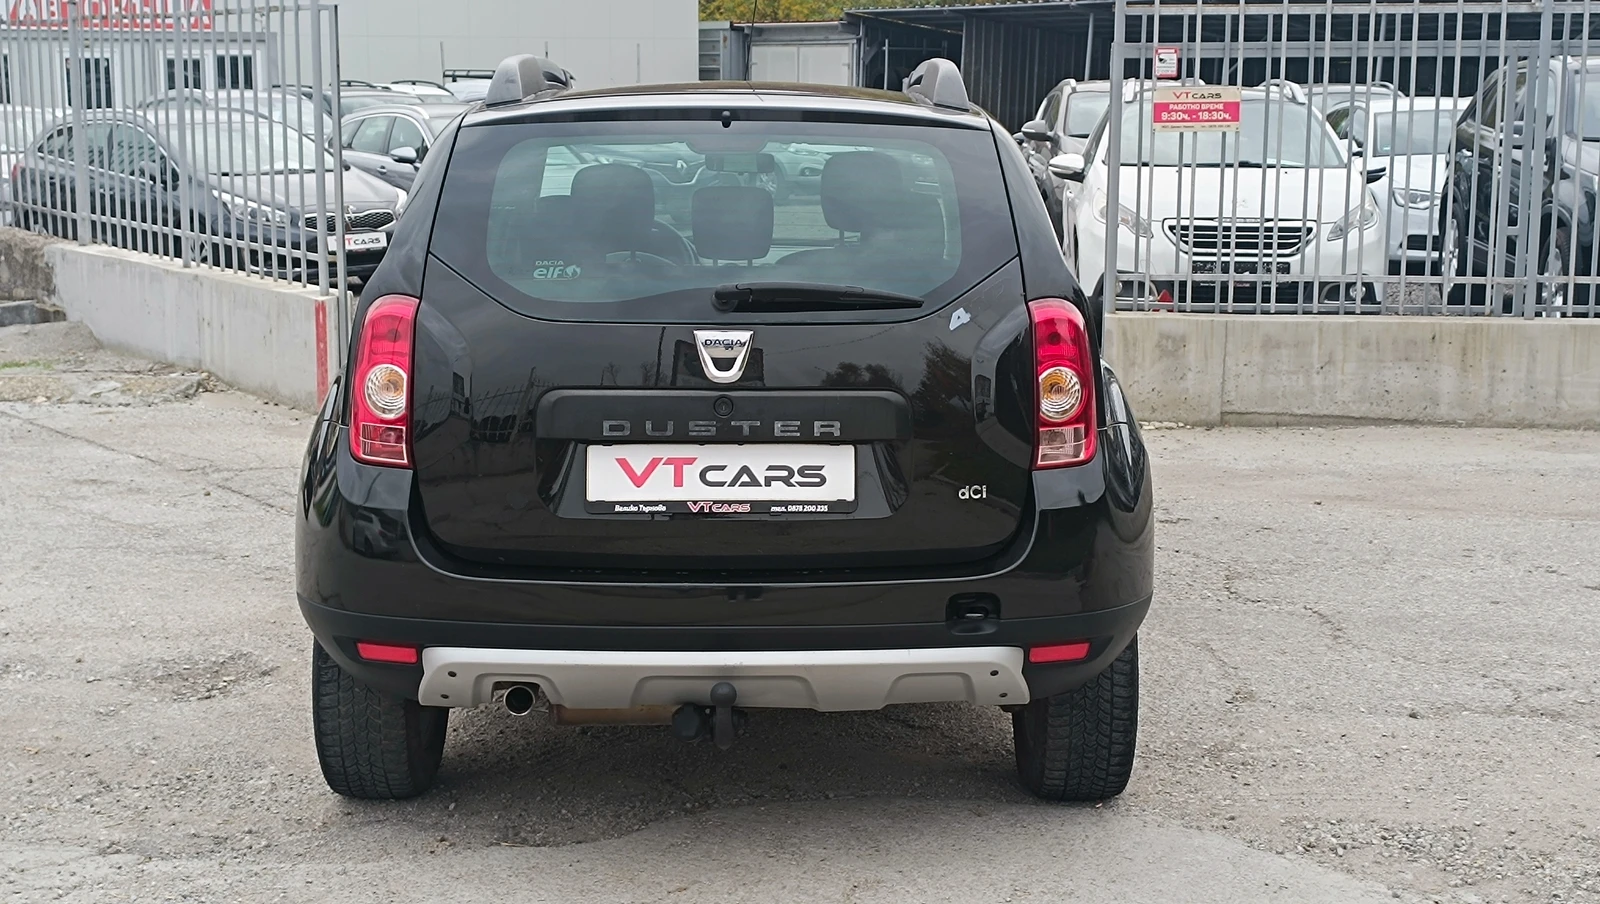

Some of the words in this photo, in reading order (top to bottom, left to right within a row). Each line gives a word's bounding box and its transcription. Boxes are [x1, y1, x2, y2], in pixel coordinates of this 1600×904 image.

[1172, 91, 1191, 99] VT
[1161, 111, 1190, 120] 9:30ч.
[1198, 111, 1231, 120] 18:30ч.
[353, 237, 381, 246] CARS
[533, 266, 564, 279] elf
[704, 338, 743, 346] DACIA
[602, 420, 842, 437] DUSTER
[615, 457, 698, 488] VT
[699, 464, 827, 488] CARS
[958, 484, 987, 500] dCi
[712, 503, 751, 513] CARS
[803, 504, 816, 512] 200
